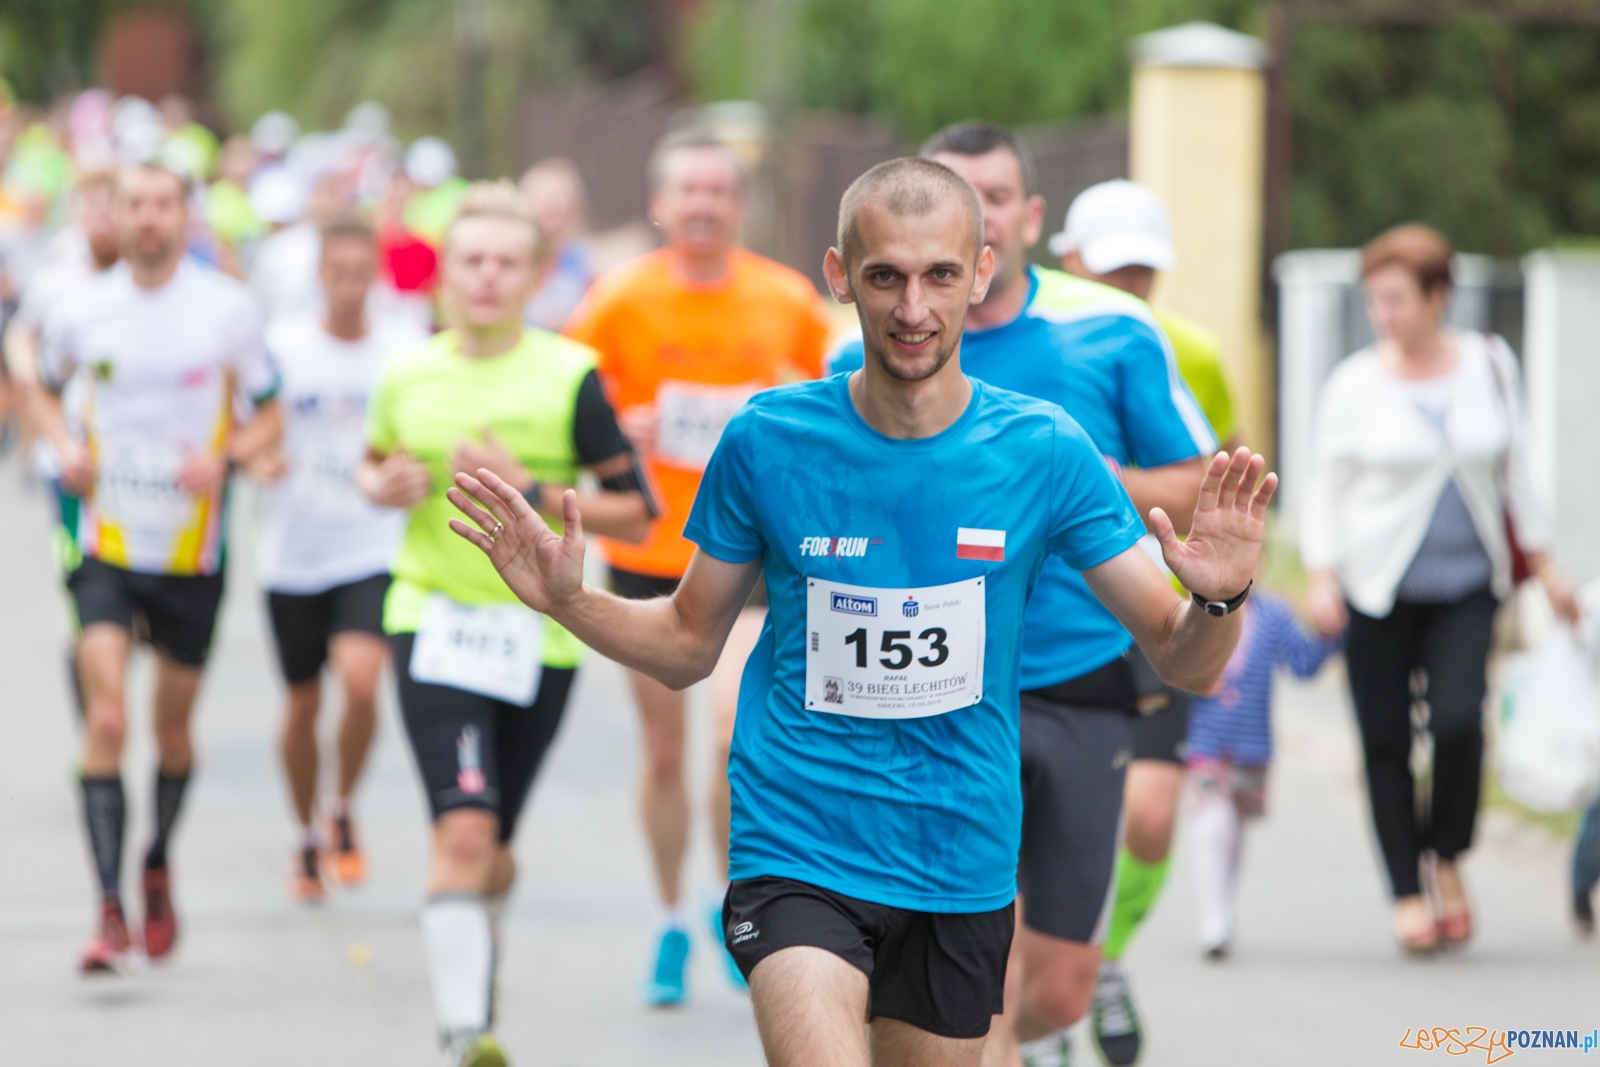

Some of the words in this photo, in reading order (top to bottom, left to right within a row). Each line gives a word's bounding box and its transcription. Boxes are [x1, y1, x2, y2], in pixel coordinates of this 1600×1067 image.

[923, 602, 941, 611] Bank
[942, 597, 962, 608] Polski
[844, 627, 950, 670] 153
[847, 681, 864, 695] 39
[867, 683, 900, 695] BIEG
[903, 672, 968, 695] LECHITÓW
